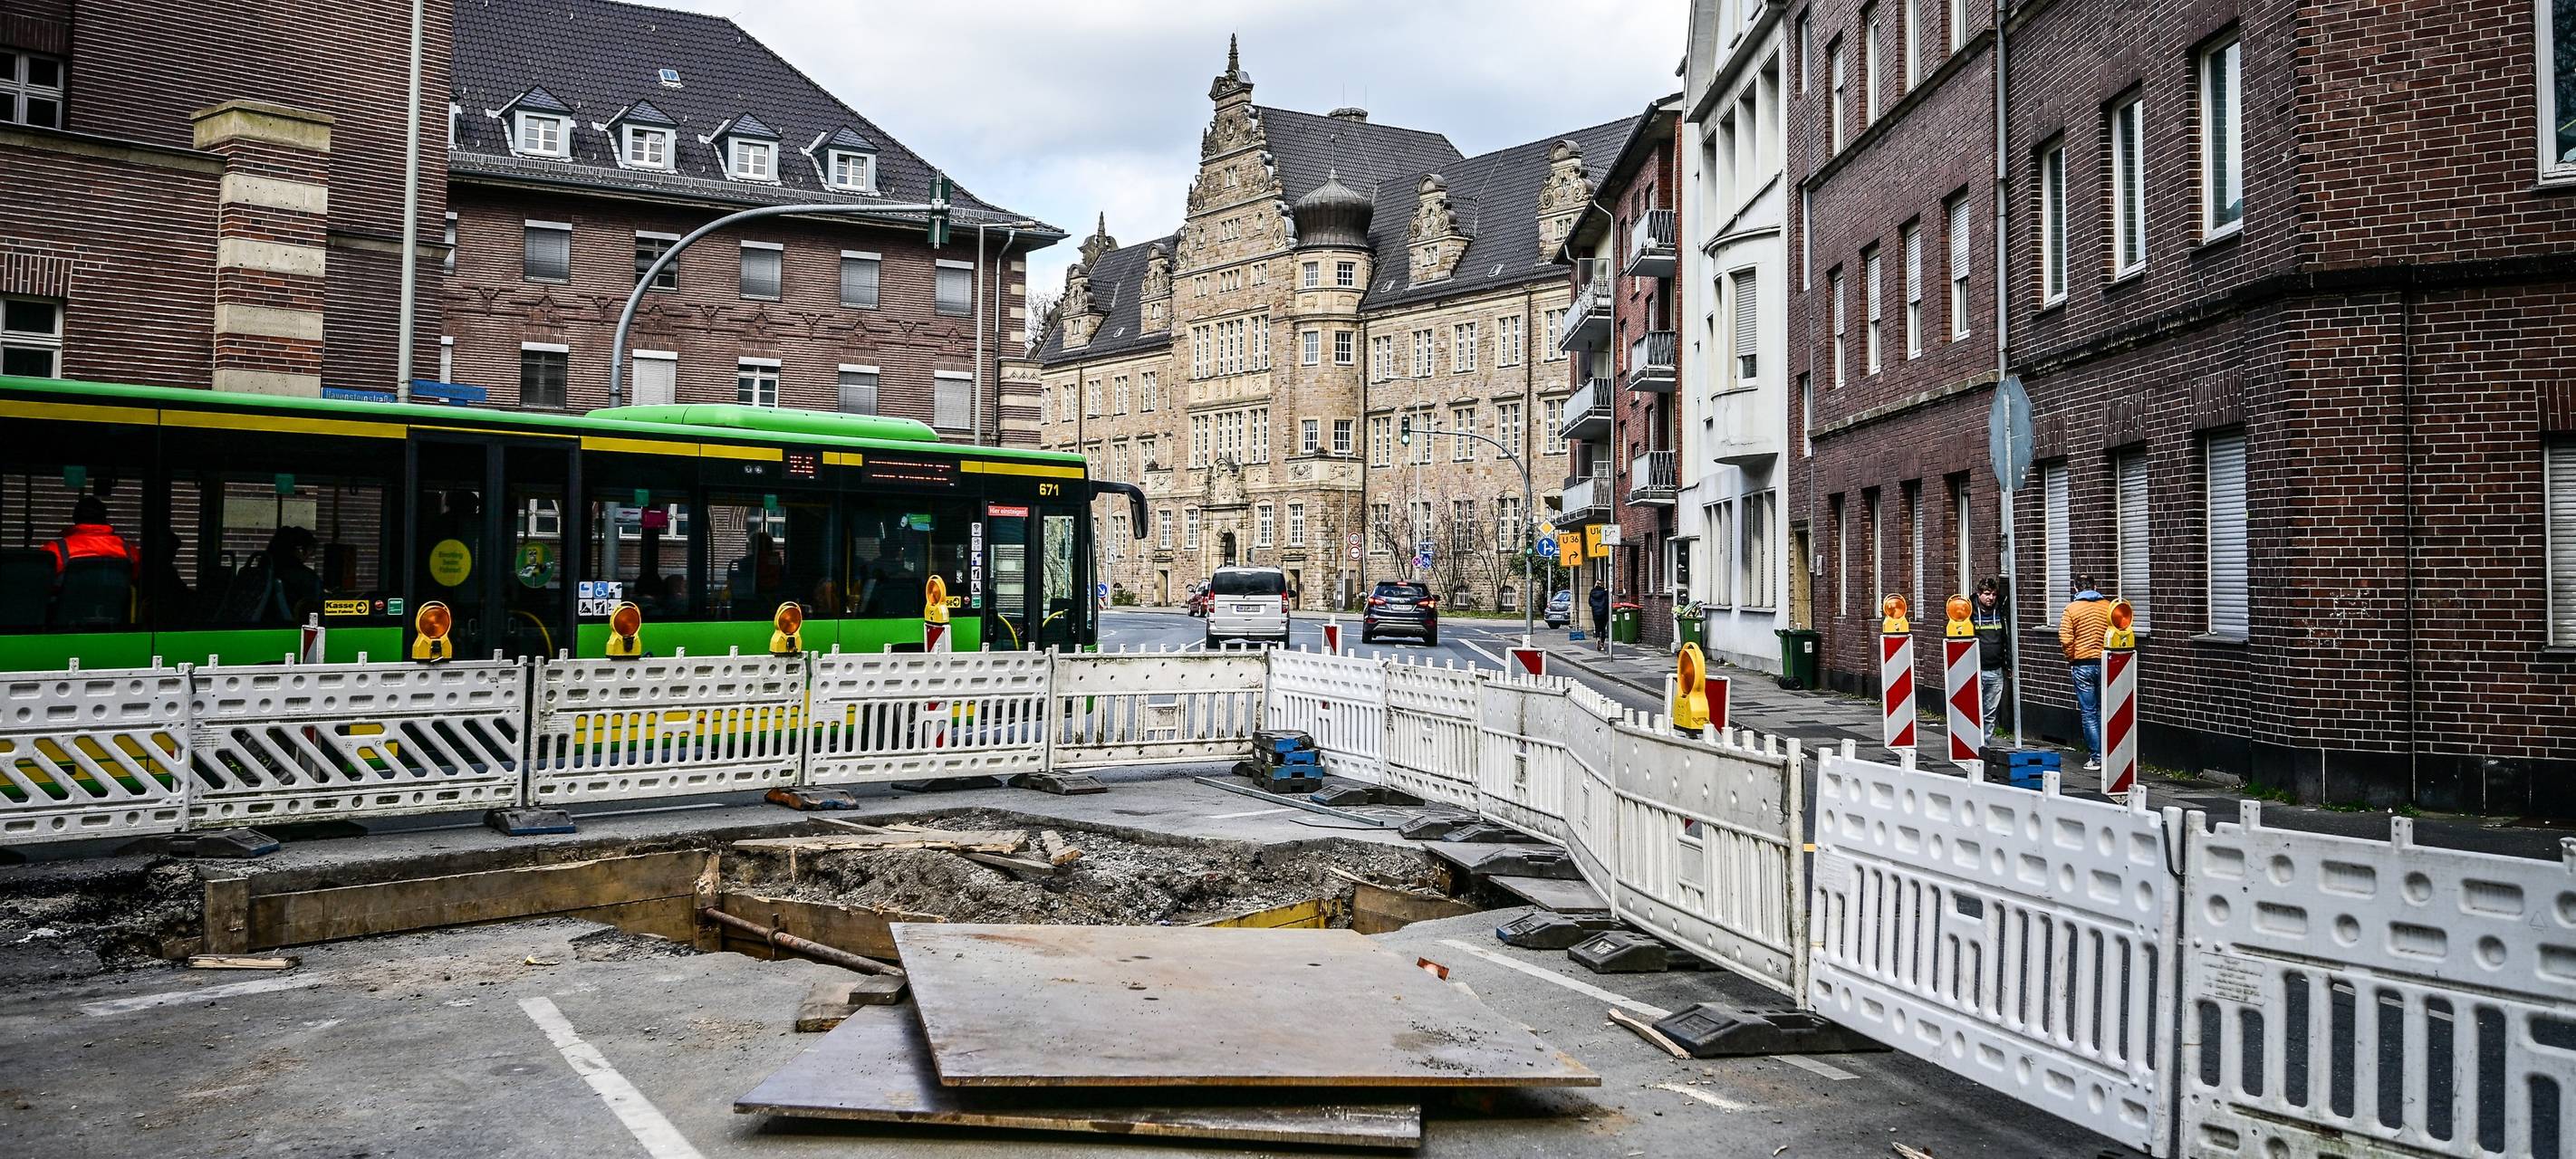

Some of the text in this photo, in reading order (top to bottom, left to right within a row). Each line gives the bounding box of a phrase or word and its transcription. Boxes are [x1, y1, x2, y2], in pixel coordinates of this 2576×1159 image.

[1039, 484, 1059, 496] 671
[989, 506, 1000, 514] Hier
[1571, 535, 1579, 543] 36
[326, 601, 354, 609] Kasse
